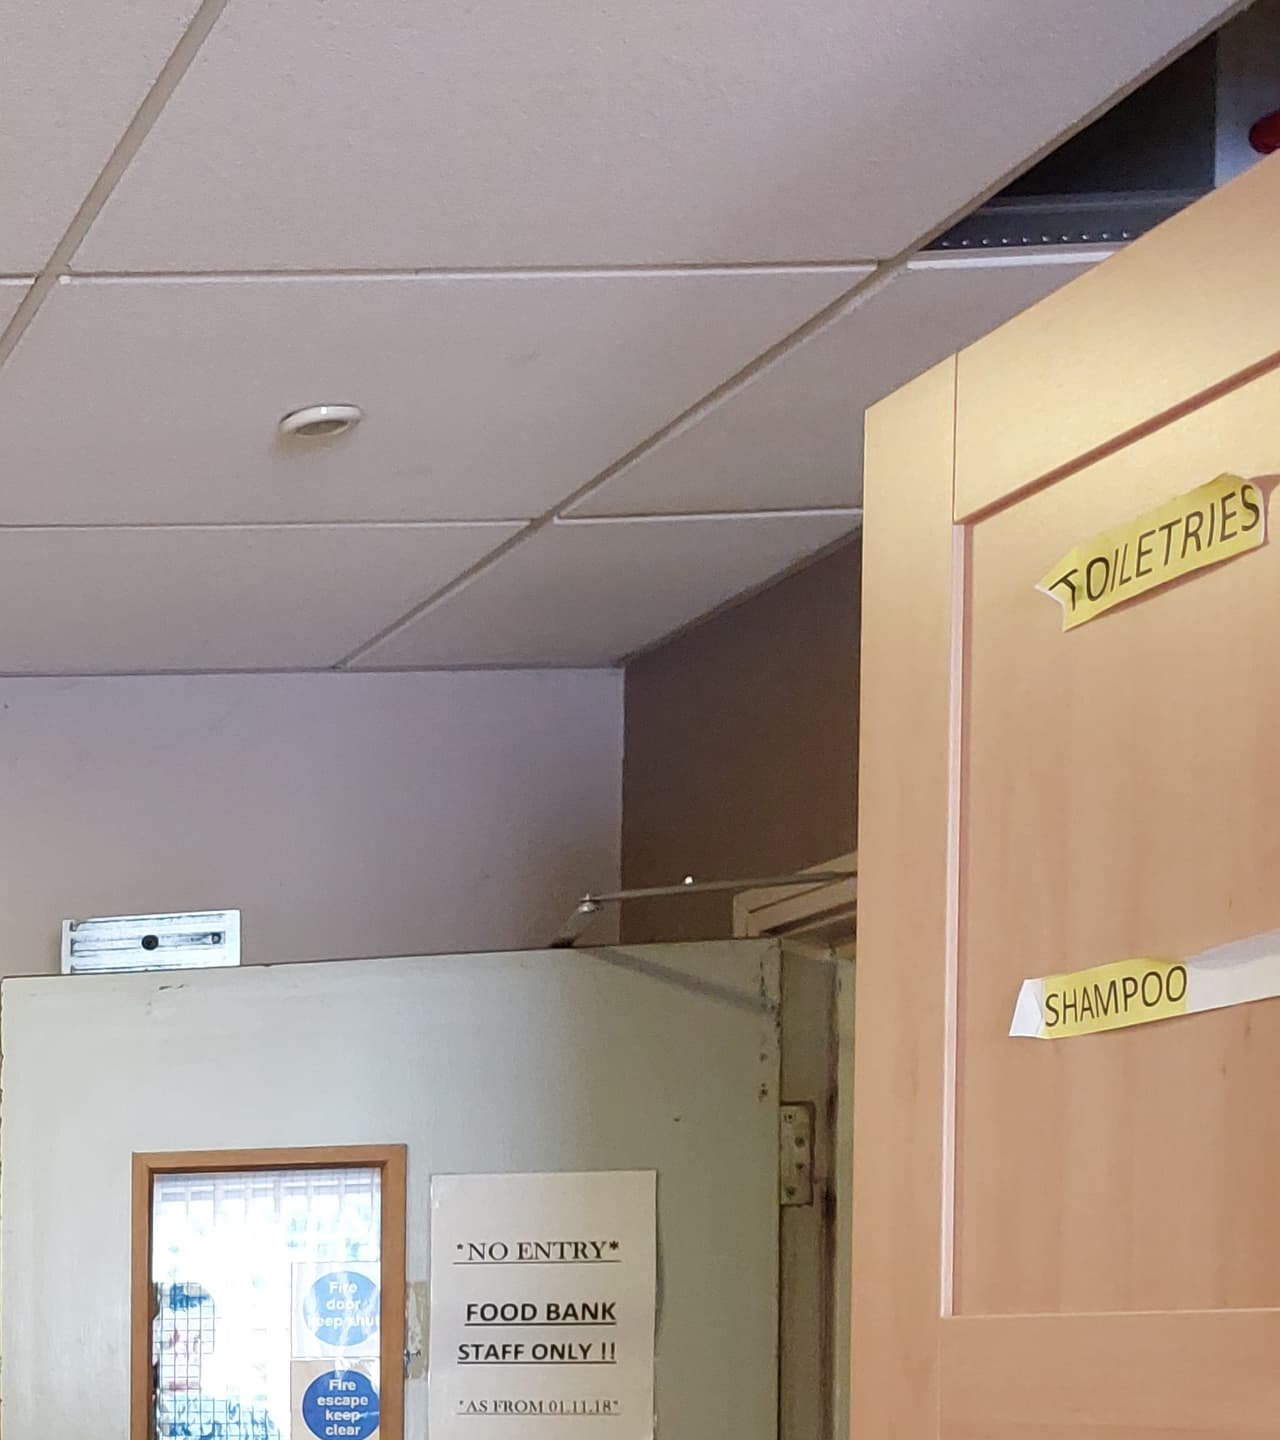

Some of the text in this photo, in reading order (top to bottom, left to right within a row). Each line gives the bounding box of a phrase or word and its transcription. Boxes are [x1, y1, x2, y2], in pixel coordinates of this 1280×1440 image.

[1049, 483, 1261, 610] TOILETRIES
[1044, 965, 1187, 1027] SHAMPOO
[329, 1281, 358, 1294] Fire
[326, 1299, 360, 1310] door
[466, 1302, 617, 1321] FOOD BANK
[347, 1314, 379, 1327] shu
[457, 1344, 524, 1361] STAFF
[532, 1343, 592, 1360] ONLY
[329, 1379, 356, 1391] Fire
[317, 1395, 368, 1409] escape
[493, 1400, 543, 1413] FROM
[325, 1409, 361, 1423] keep
[325, 1424, 361, 1436] clear
